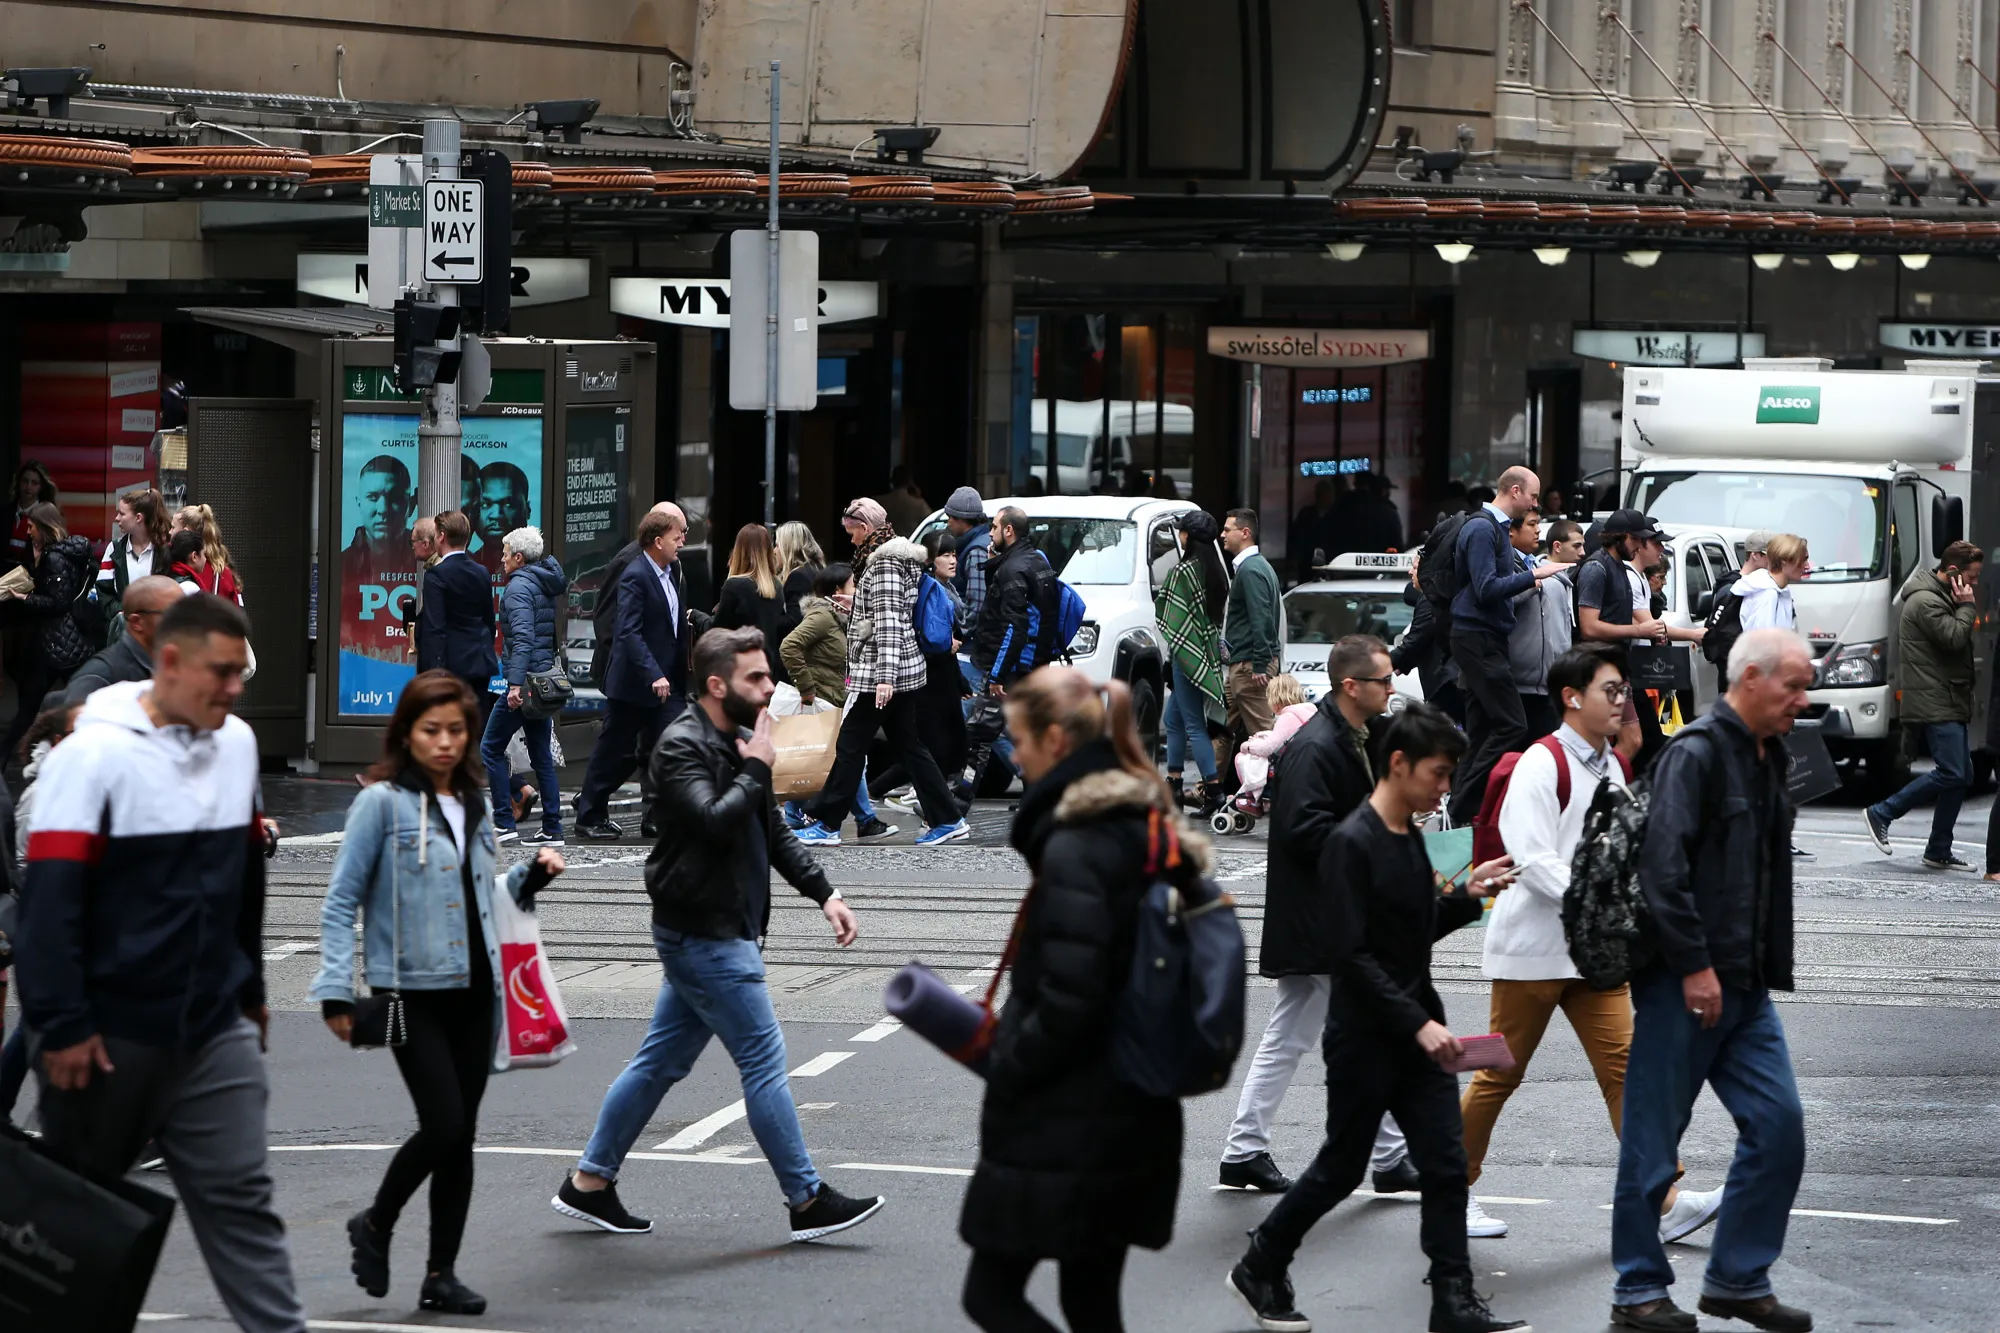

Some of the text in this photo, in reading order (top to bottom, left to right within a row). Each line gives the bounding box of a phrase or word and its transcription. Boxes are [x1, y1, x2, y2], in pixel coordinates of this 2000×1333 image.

[384, 191, 421, 211] Market St
[434, 190, 473, 212] ONE
[431, 221, 475, 243] WAY
[660, 285, 827, 316] MY
[1228, 332, 1407, 357] swissôtel SYDNEY
[1762, 396, 1812, 409] ALSCO
[501, 407, 542, 415] JCDecaux
[381, 440, 508, 449] CURTIS JACKSON
[567, 457, 595, 473] THE BMW
[567, 472, 617, 490] END OF FINANCIAL
[567, 491, 583, 506] YEAR
[583, 490, 598, 505] SALE
[1355, 555, 1398, 567] 13CABS
[380, 572, 417, 581] RESPECT
[352, 690, 393, 706] July 1
